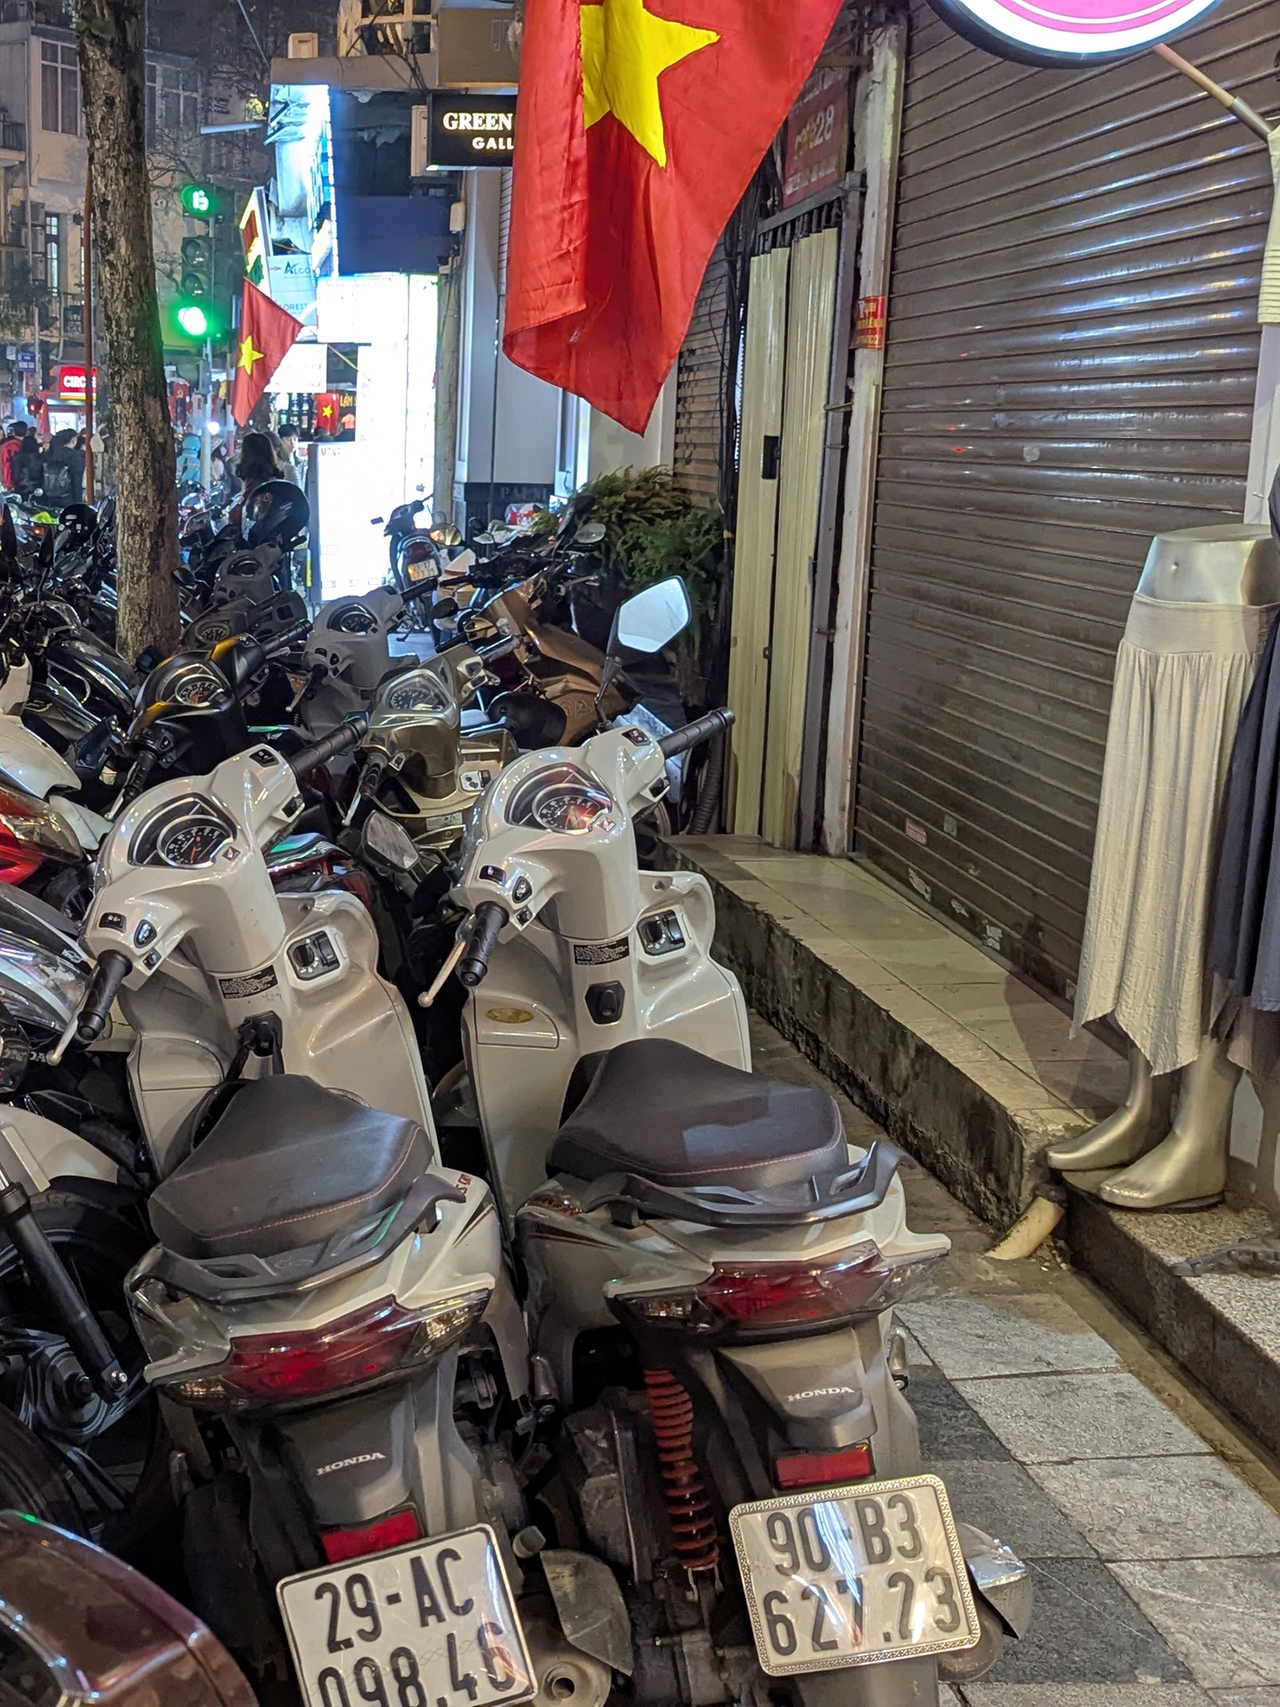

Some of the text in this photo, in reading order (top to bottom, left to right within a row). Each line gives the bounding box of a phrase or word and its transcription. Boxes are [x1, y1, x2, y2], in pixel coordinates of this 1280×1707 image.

[442, 112, 514, 131] GREEN
[472, 136, 515, 150] GALL
[280, 303, 308, 311] OREST
[63, 375, 97, 388] CIRCE
[787, 1385, 855, 1403] HONDA
[316, 1451, 387, 1476] HONDA
[766, 1493, 925, 1577] 90-B3
[314, 1547, 475, 1654] 29-AC
[763, 1566, 961, 1657] 627.23
